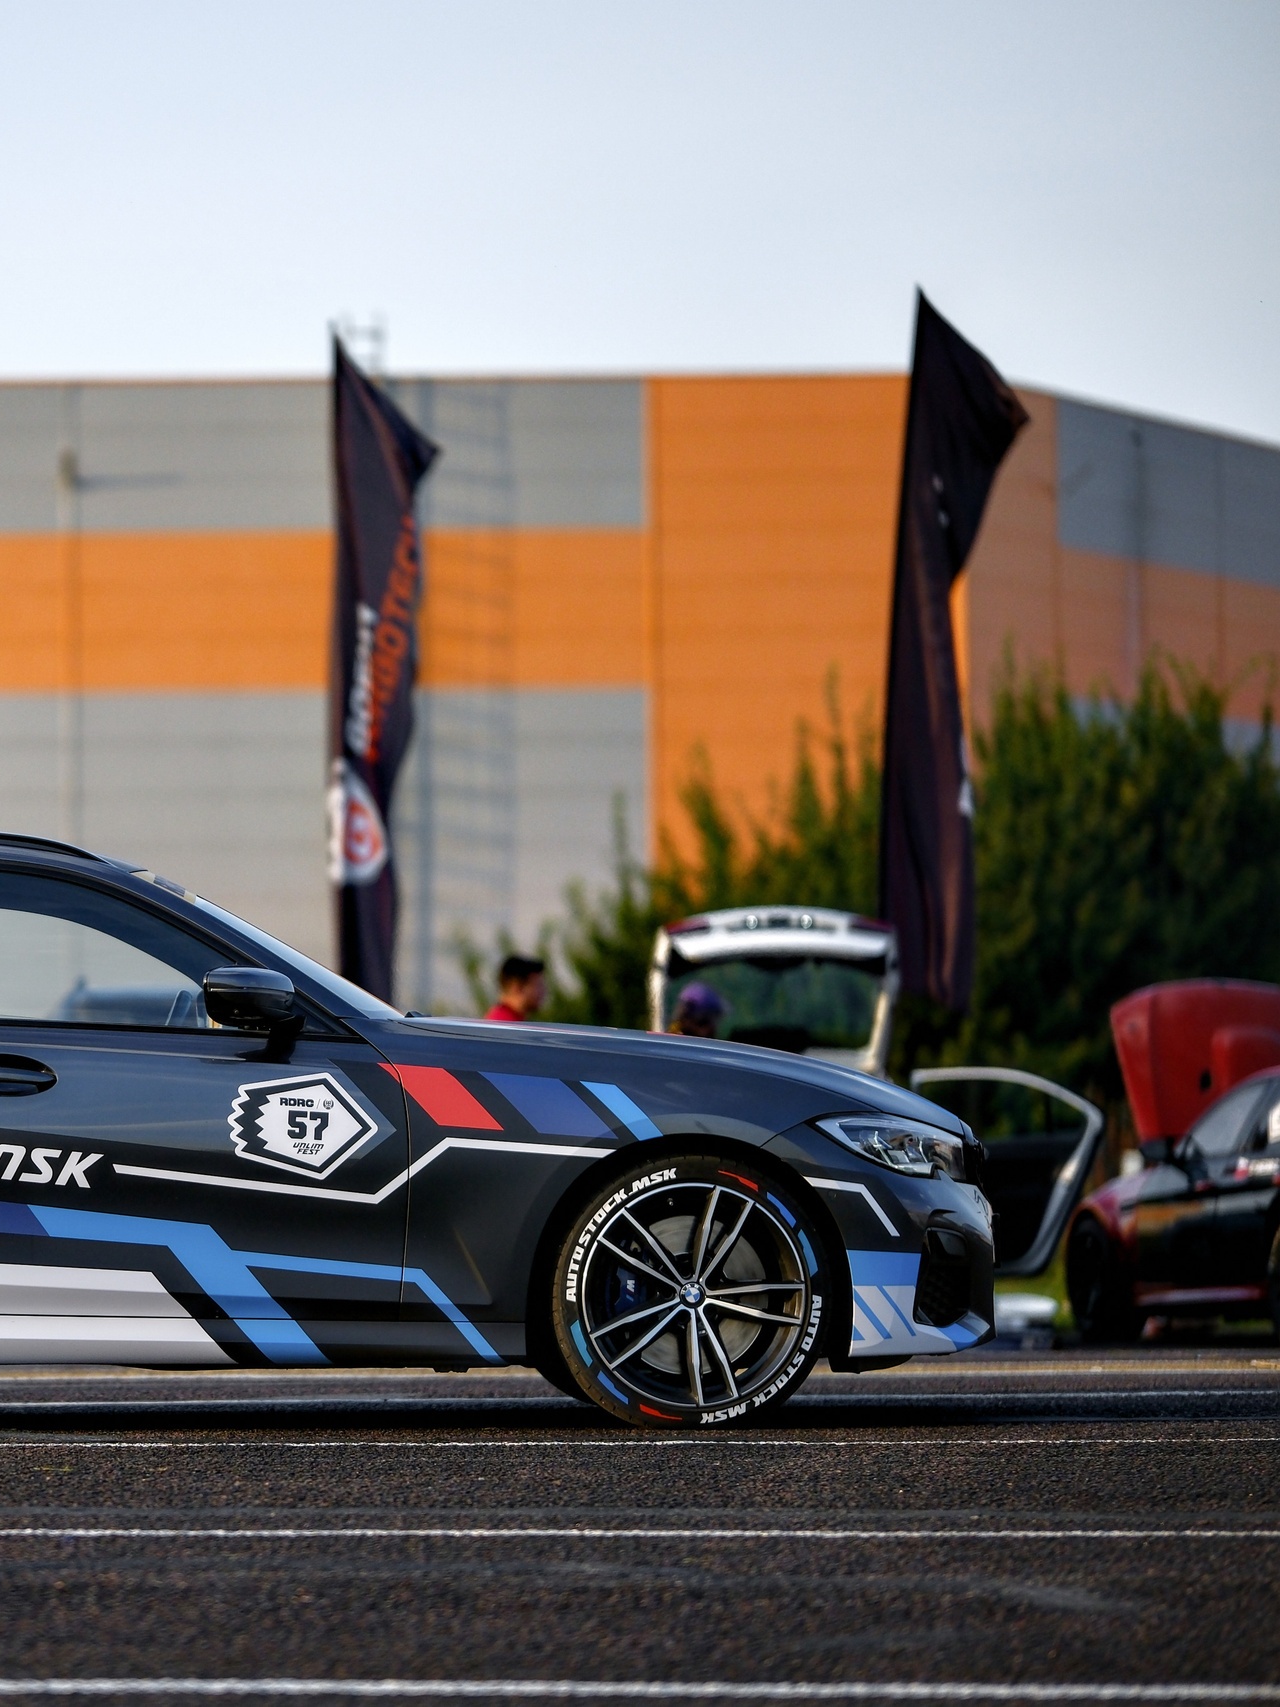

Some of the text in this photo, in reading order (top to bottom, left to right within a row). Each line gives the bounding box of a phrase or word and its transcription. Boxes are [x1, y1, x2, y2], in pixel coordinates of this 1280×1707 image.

[279, 1097, 314, 1107] RDRC
[287, 1110, 329, 1141] 57
[293, 1142, 324, 1150] UNLIM
